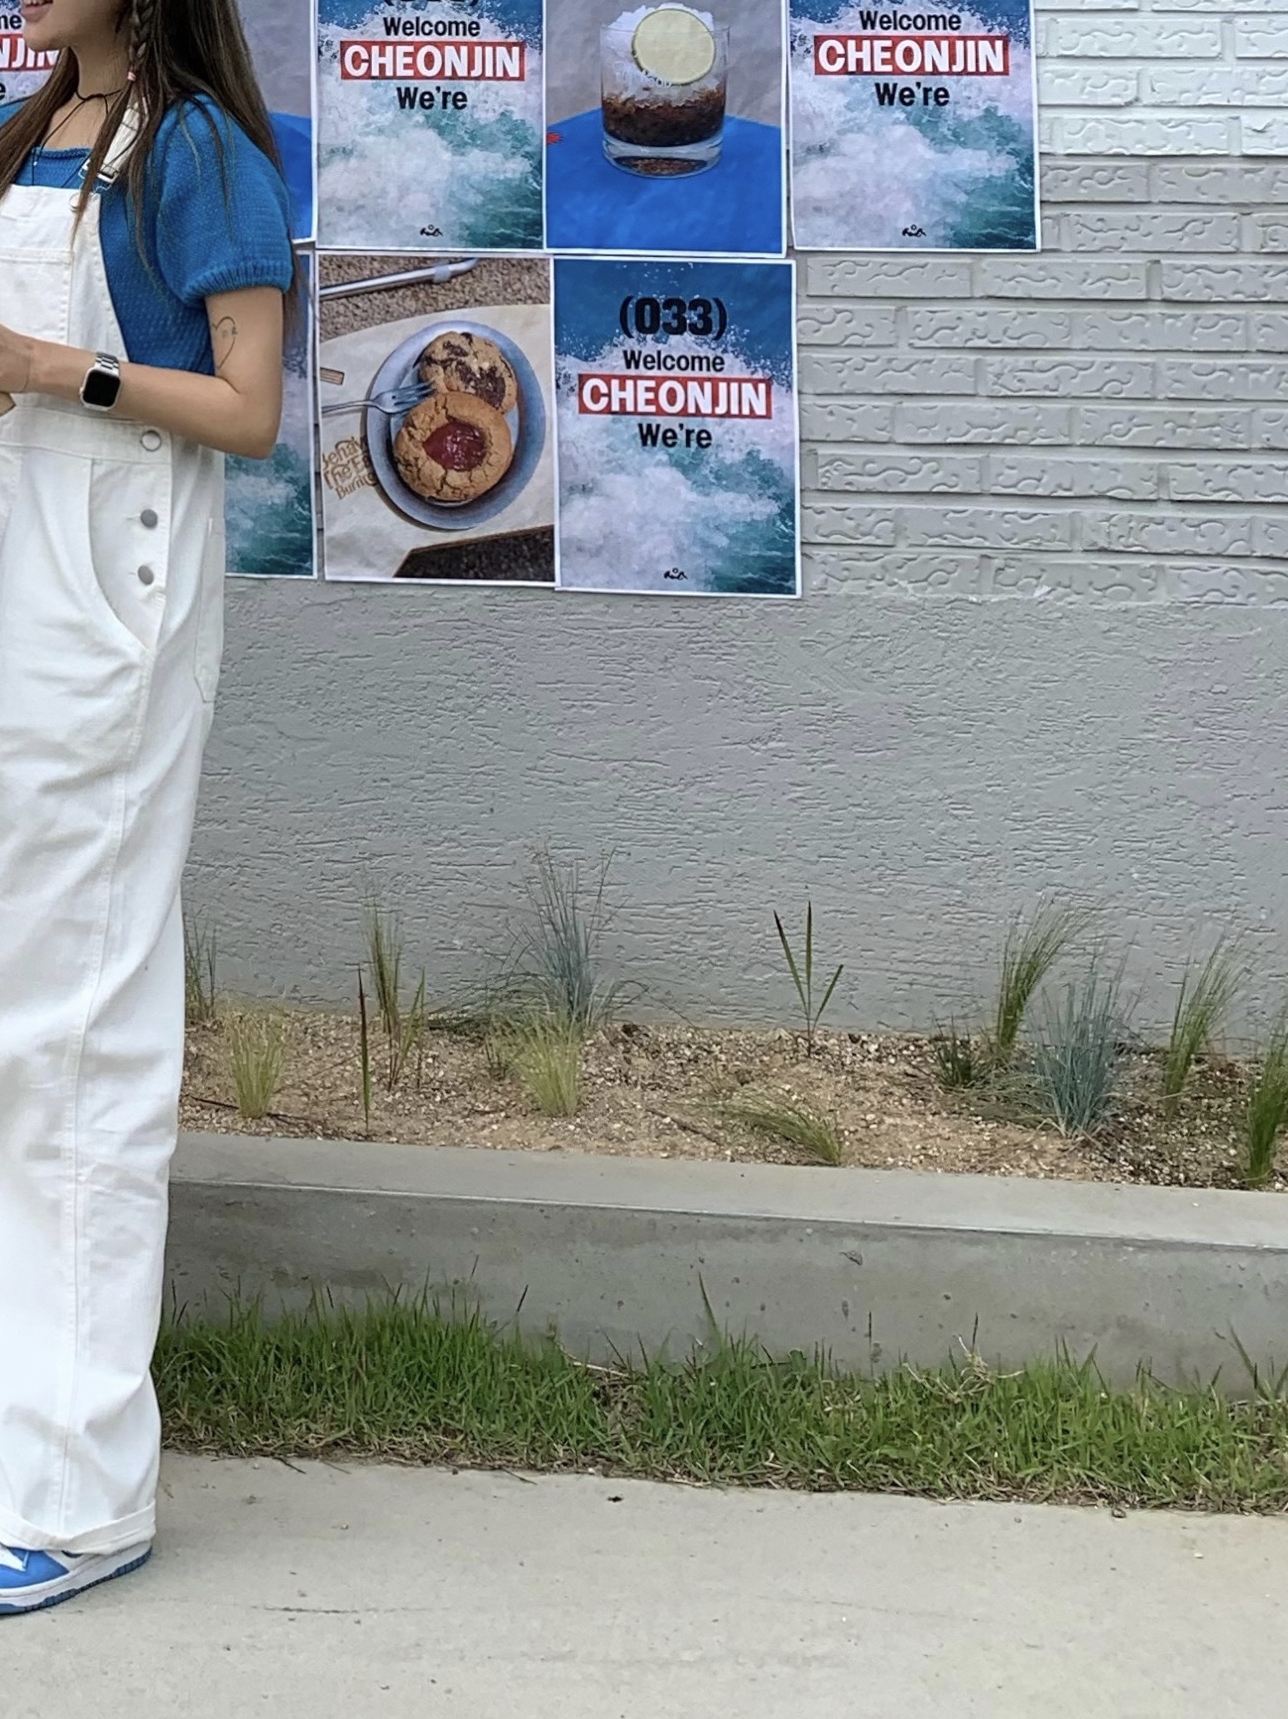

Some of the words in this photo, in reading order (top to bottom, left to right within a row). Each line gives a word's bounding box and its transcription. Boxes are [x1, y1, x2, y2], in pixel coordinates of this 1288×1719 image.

[383, 16, 480, 36] Welcome
[859, 10, 961, 30] Welcome
[344, 44, 520, 78] CHEONJIN
[818, 39, 1004, 72] CHEONJIN
[397, 86, 468, 110] We're
[875, 82, 950, 106] We're
[619, 295, 727, 340] (033)
[623, 350, 725, 372] Welcome
[582, 378, 767, 415] CHEONJIN
[638, 423, 712, 448] We're
